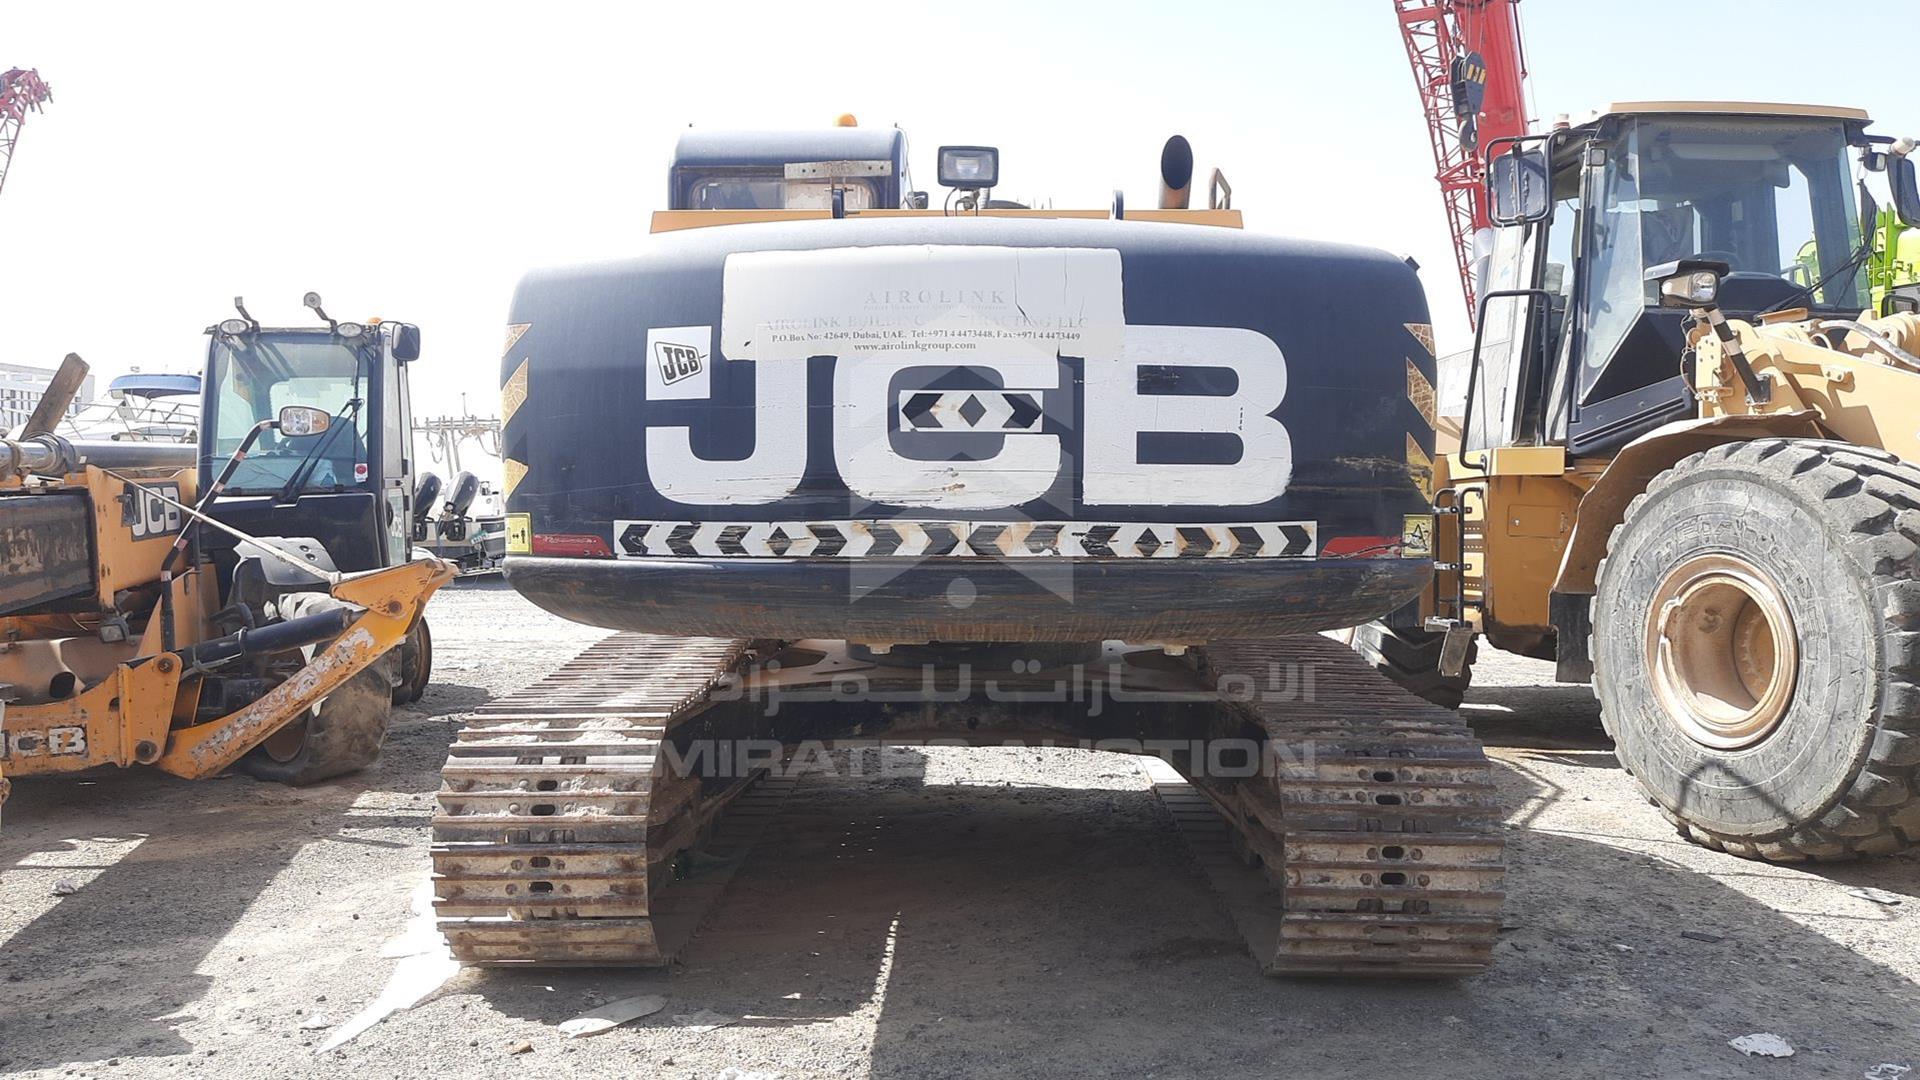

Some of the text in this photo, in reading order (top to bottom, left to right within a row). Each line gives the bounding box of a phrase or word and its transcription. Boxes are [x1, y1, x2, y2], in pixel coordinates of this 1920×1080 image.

[865, 290, 1004, 304] AIROLINK
[854, 340, 976, 351] www.airolinkgroup.com
[662, 347, 699, 380] JCB
[645, 324, 1292, 510] JCB
[131, 486, 181, 536] JCB
[0, 727, 86, 758] CB
